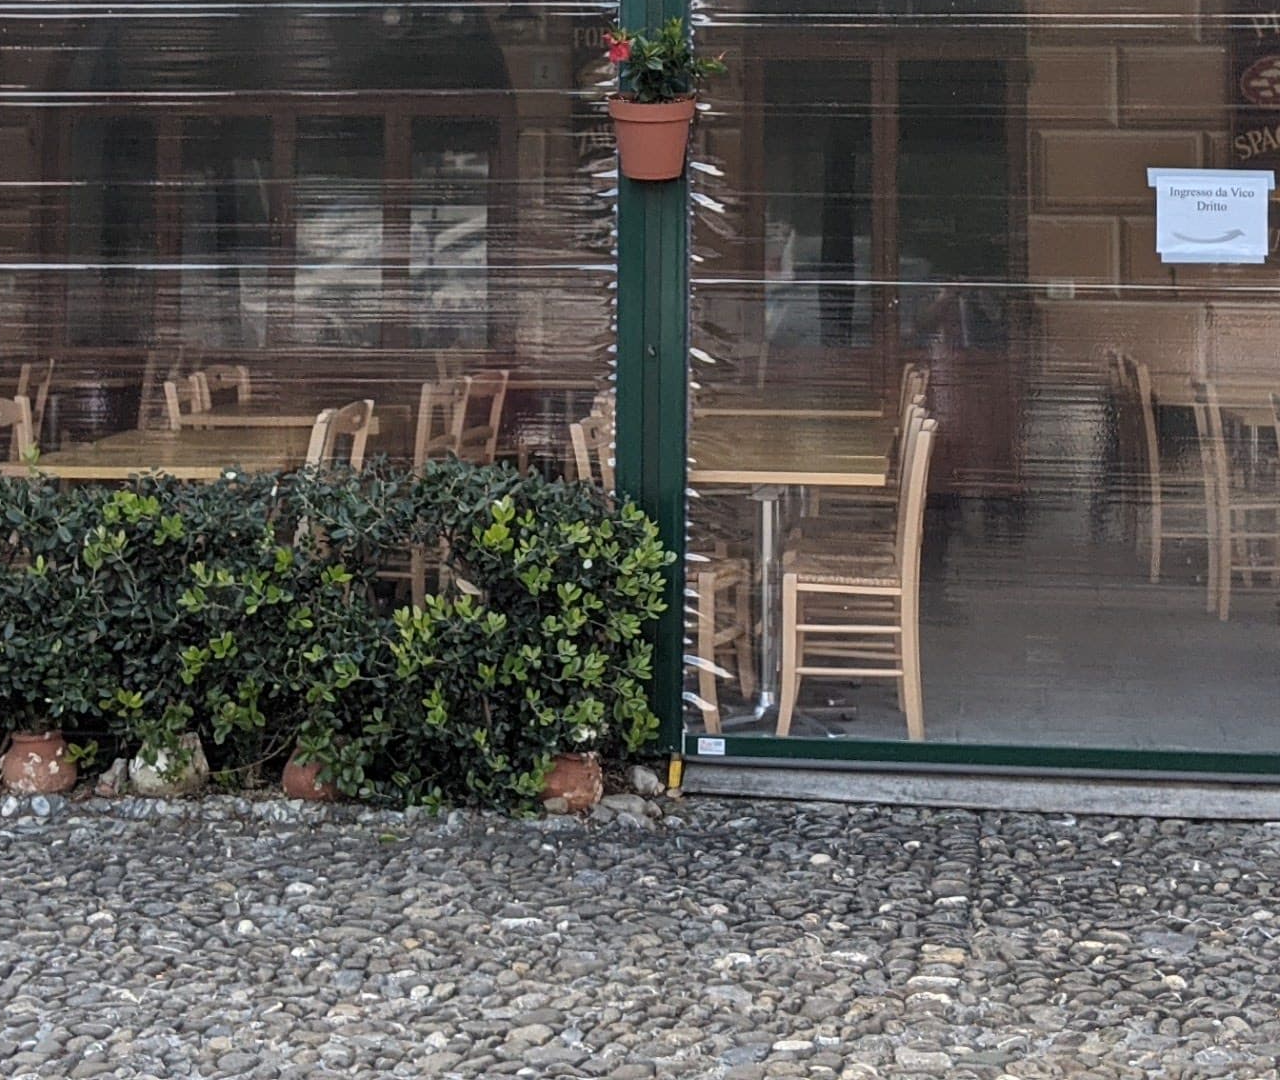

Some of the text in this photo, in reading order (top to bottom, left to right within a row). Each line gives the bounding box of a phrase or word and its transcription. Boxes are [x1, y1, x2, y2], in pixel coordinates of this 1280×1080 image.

[1169, 186, 1255, 199] Ingresso da Vico
[1196, 200, 1228, 212] Dritto
